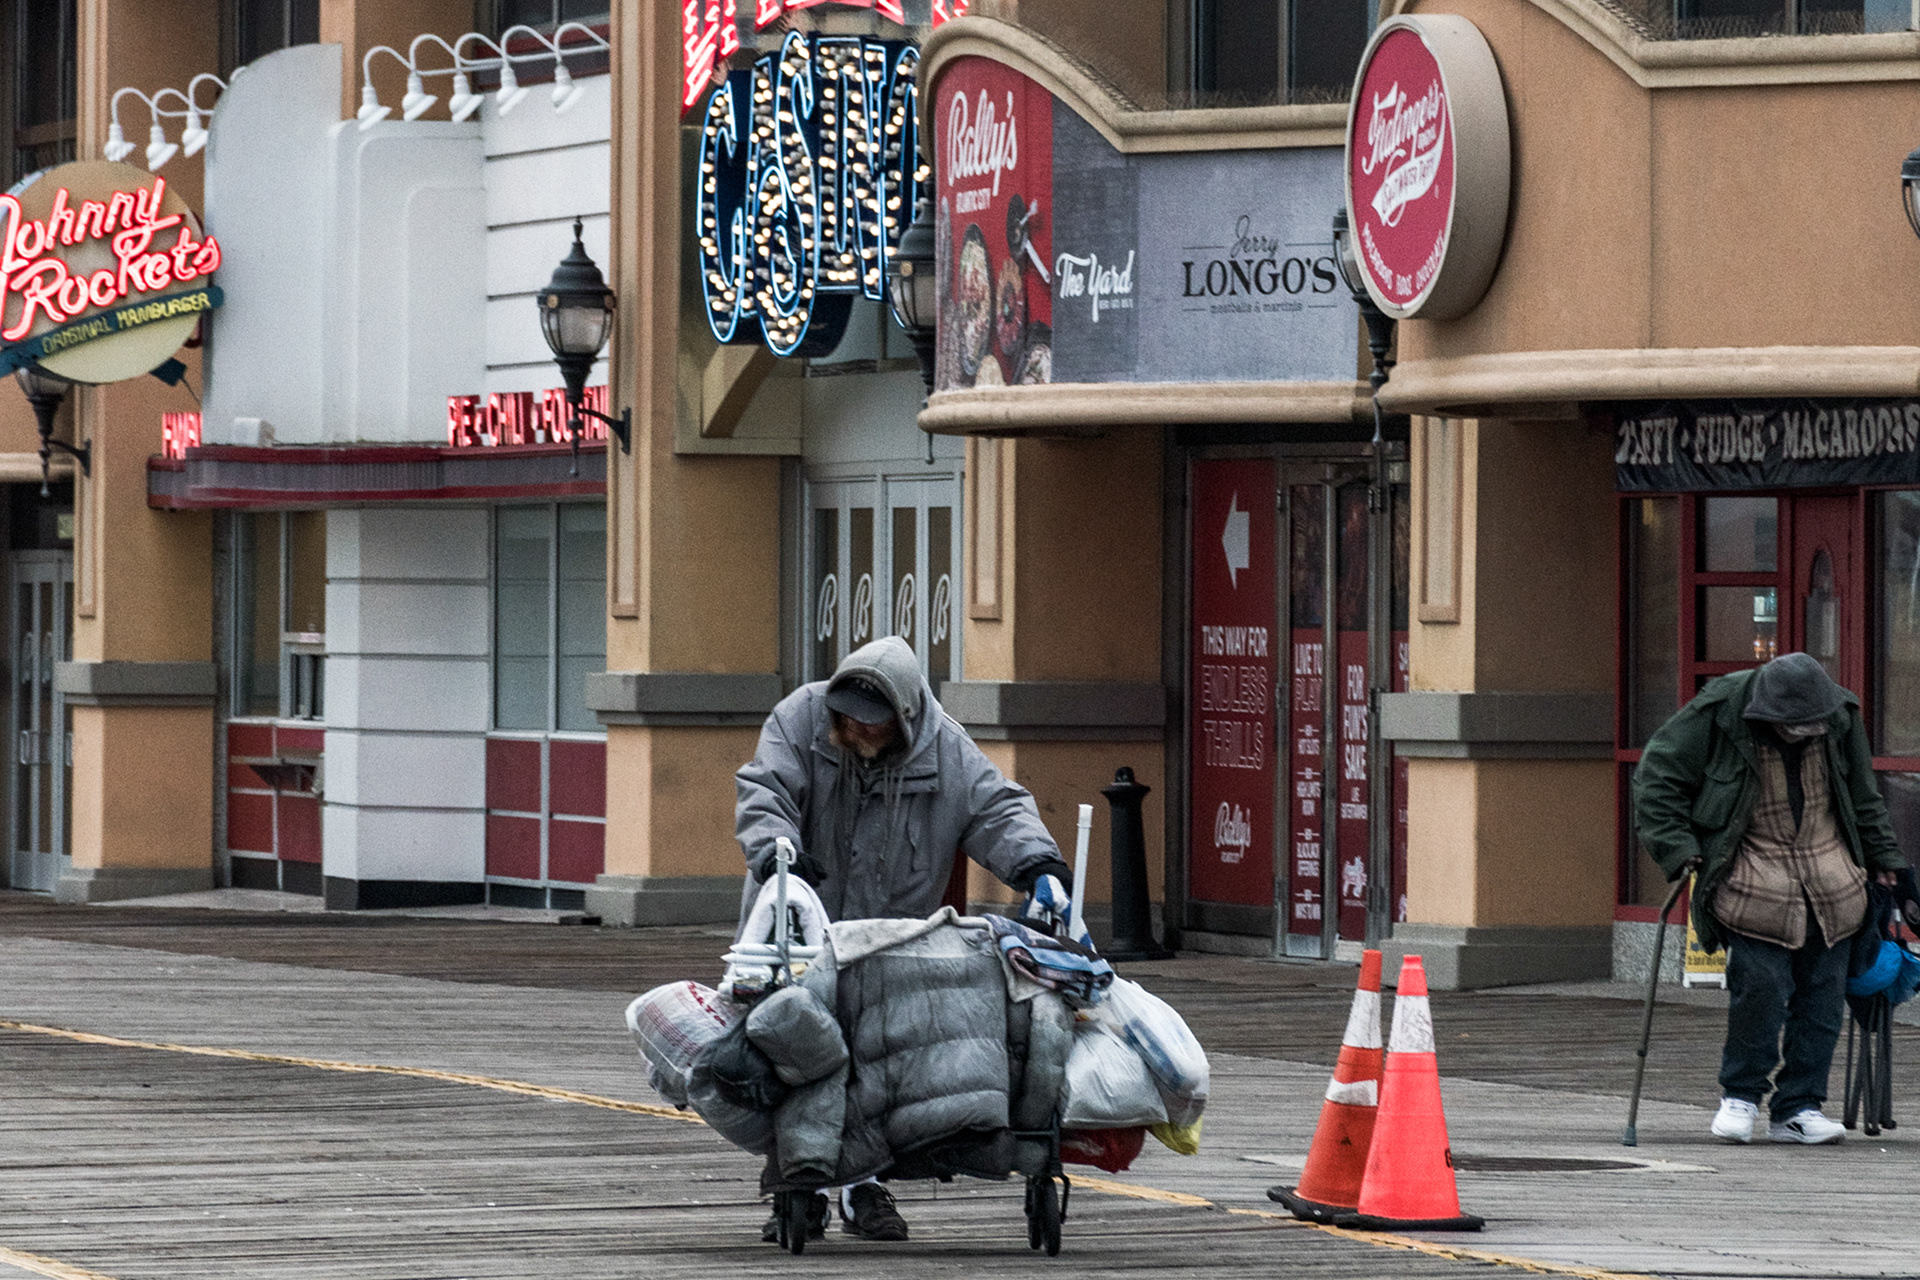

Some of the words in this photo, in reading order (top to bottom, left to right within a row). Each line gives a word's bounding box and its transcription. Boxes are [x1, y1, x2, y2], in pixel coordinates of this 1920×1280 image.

[947, 88, 1017, 196] Bally's
[2, 234, 222, 342] Rockets
[1055, 252, 1091, 299] The
[1088, 250, 1135, 323] Yard
[1182, 256, 1337, 297] LONGO'S
[115, 292, 211, 329] HAMBURGER
[1693, 415, 1766, 464] FUDGE
[1202, 625, 1224, 656] THIS
[1225, 626, 1247, 656] WAY
[1248, 626, 1268, 657] FOR
